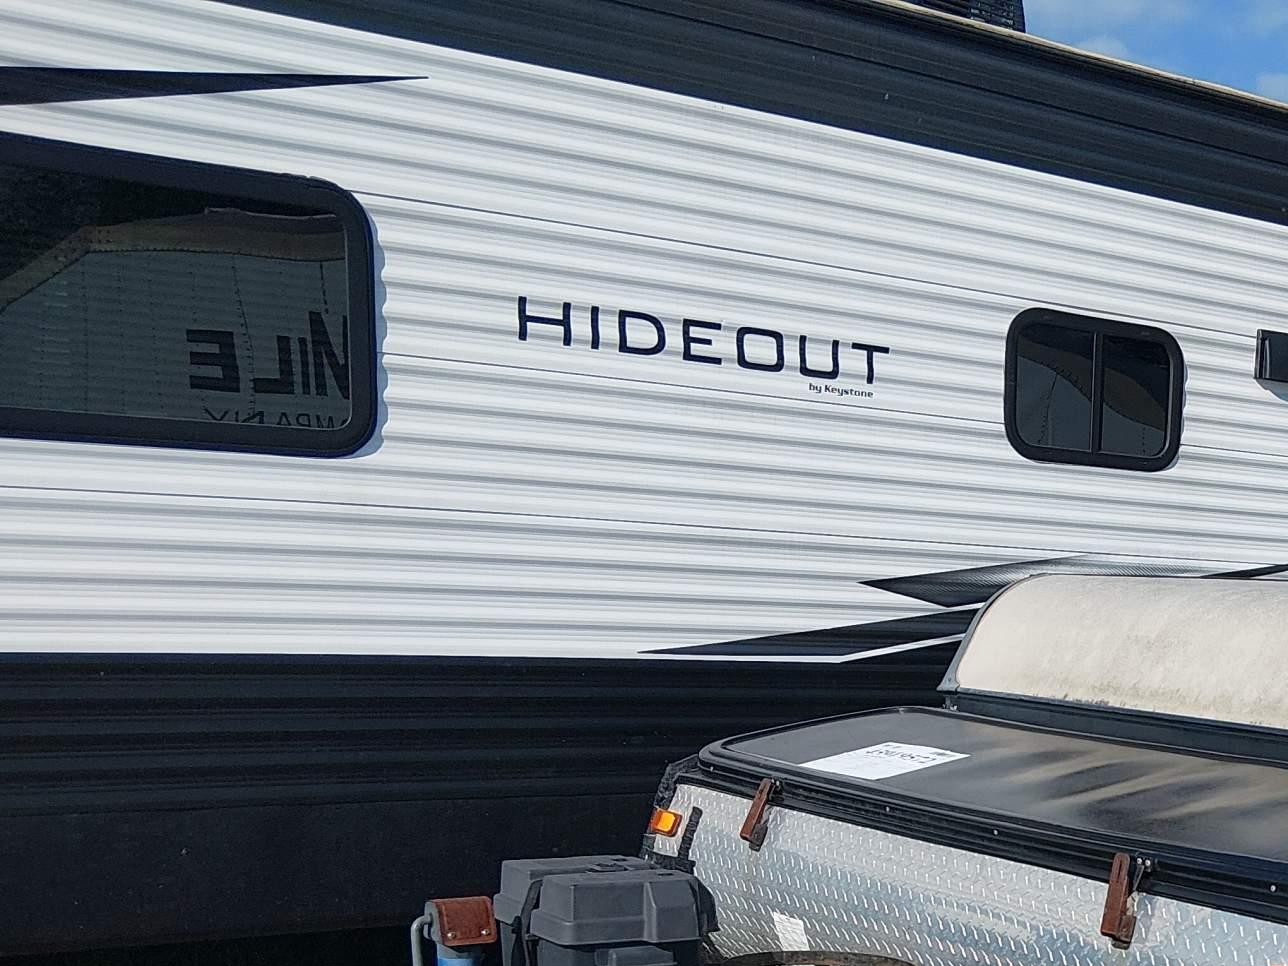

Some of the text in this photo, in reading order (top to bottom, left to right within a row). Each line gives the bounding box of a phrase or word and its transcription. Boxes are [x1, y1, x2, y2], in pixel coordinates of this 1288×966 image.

[518, 295, 890, 385] HIDEOUT
[808, 383, 874, 398] by Keystone
